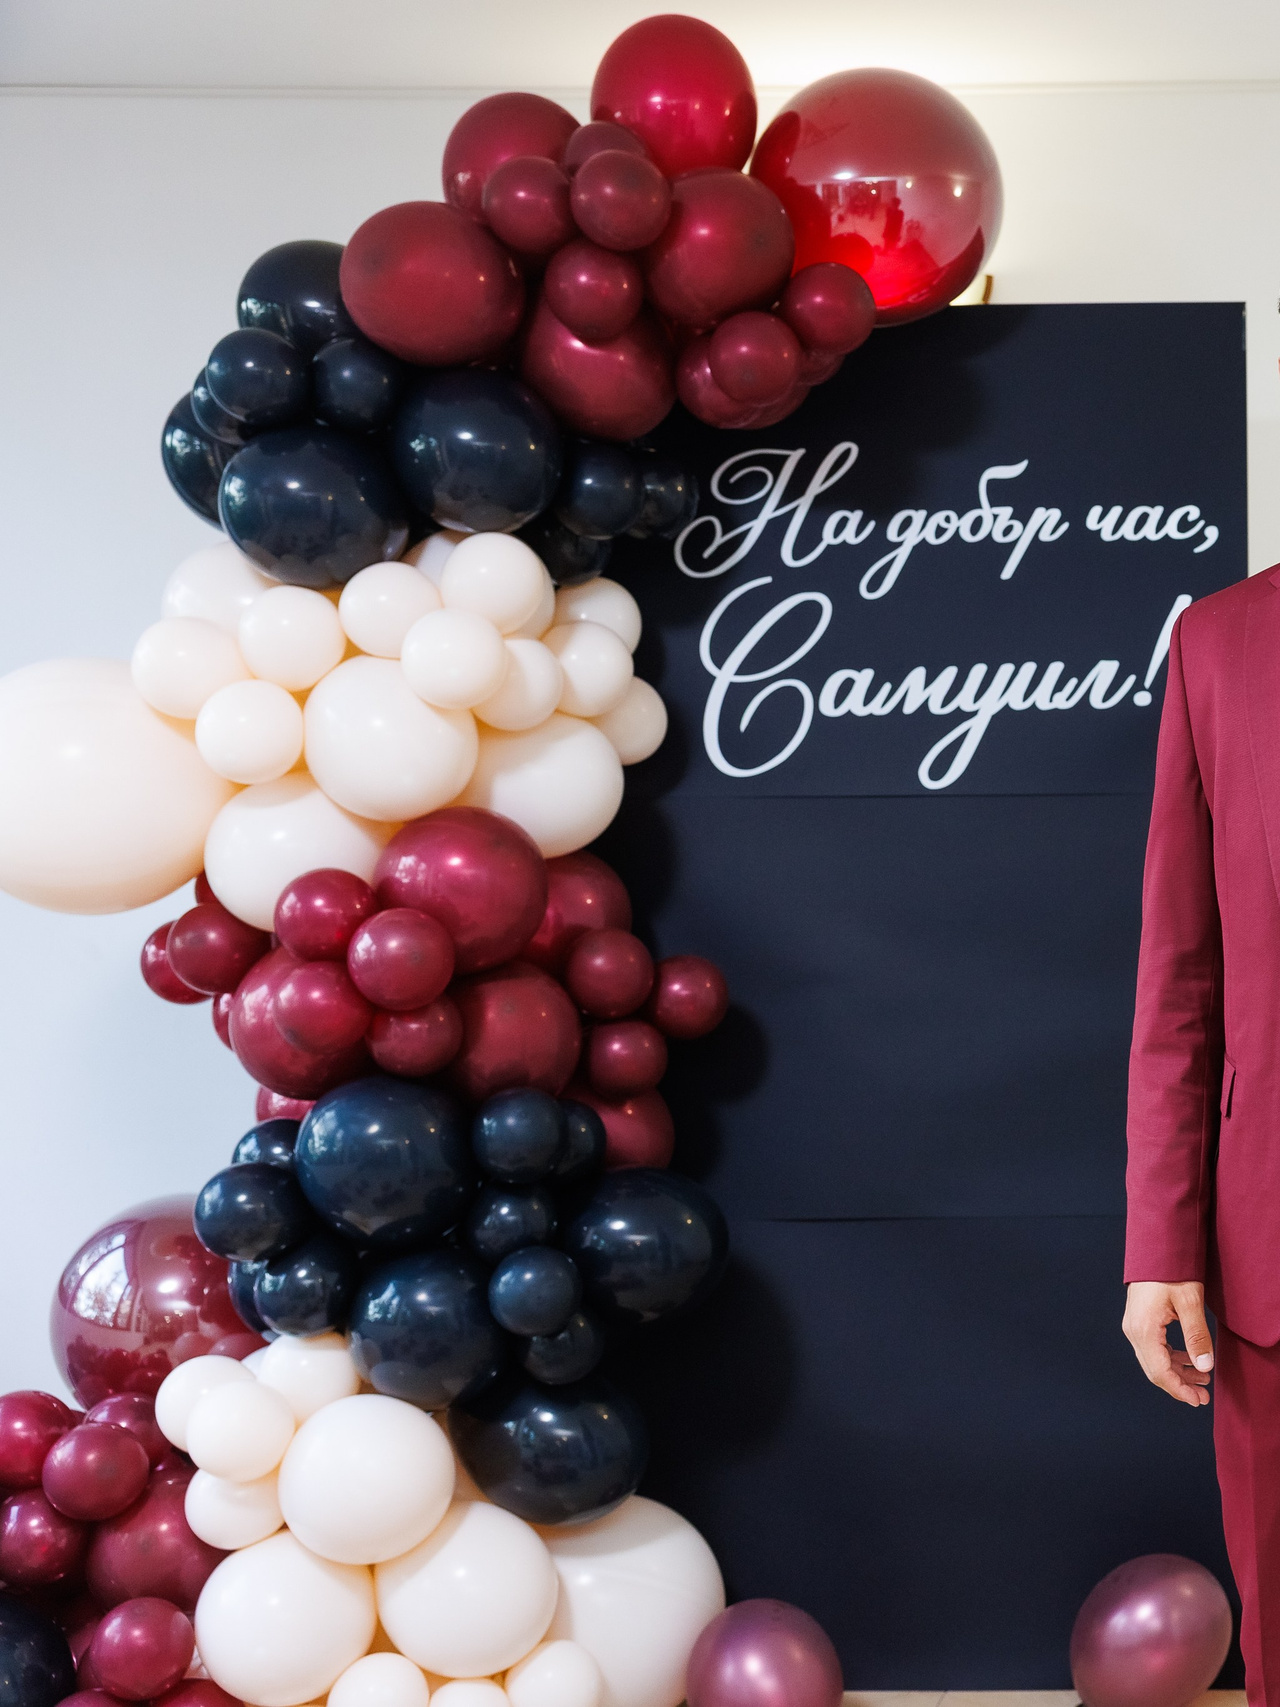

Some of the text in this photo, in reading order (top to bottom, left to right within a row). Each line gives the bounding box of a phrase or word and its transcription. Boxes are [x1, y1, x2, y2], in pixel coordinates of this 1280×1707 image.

[673, 441, 1221, 600] На добър час,
[698, 575, 1193, 791] Самуил!
